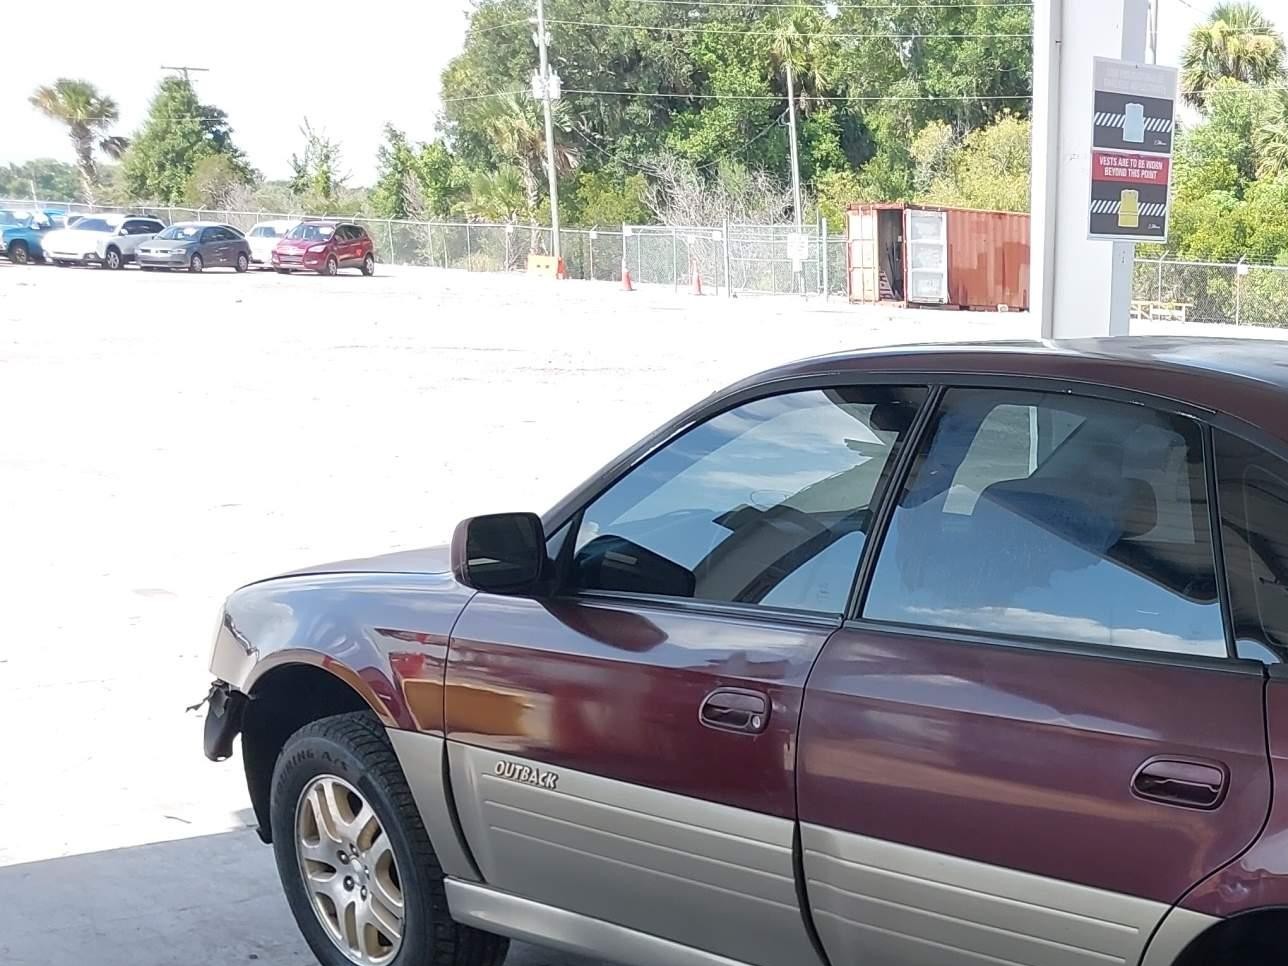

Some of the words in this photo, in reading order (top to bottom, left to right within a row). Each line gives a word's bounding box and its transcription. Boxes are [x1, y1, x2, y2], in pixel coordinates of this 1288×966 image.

[1099, 156, 1117, 166] VESTS
[1130, 158, 1138, 168] TO
[1104, 166, 1127, 177] BEYOND
[1128, 168, 1141, 178] THIS
[495, 760, 559, 789] OUTBACK
